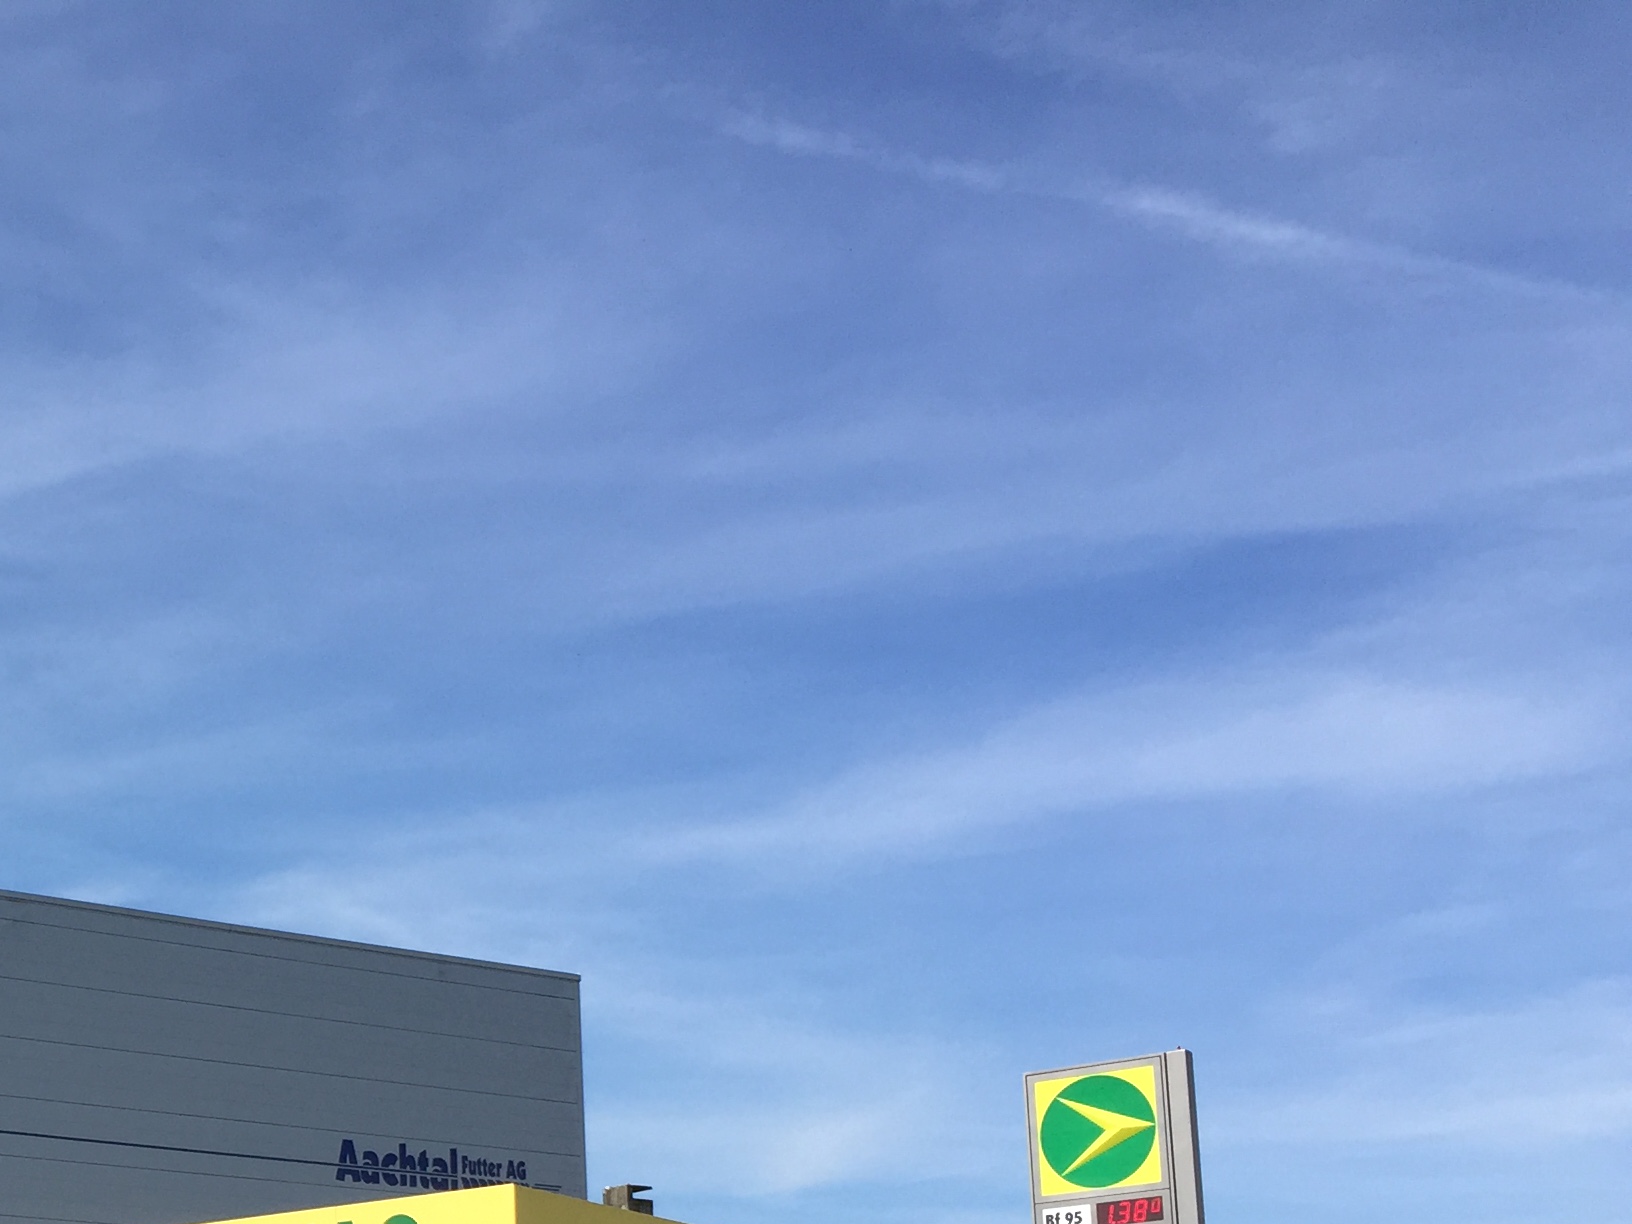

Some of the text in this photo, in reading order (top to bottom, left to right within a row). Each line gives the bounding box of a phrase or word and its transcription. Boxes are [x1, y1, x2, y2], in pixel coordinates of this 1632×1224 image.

[335, 1139, 527, 1190] Aachtal Futter AG
